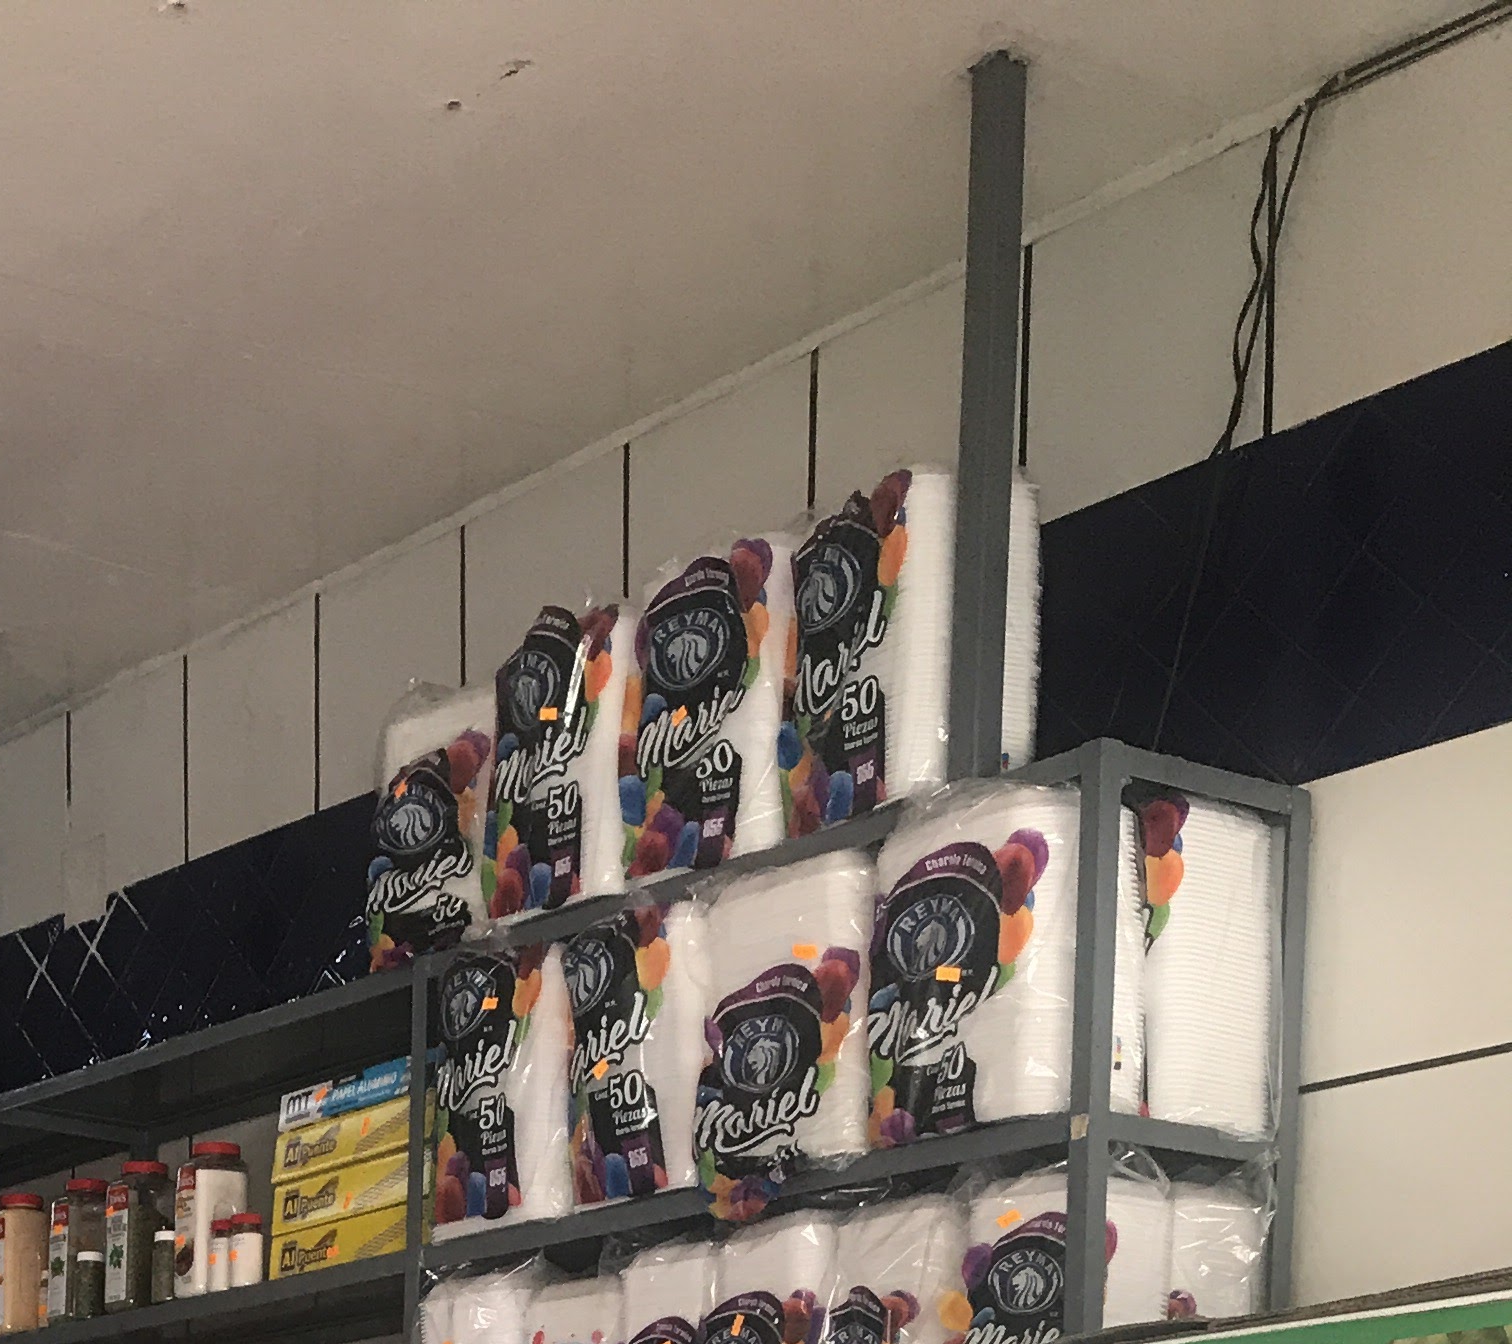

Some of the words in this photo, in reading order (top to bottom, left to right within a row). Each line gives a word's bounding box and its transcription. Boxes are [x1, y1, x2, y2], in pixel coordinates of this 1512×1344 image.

[655, 608, 723, 644] REYMA
[842, 677, 878, 721] 50
[696, 741, 733, 779] 50
[547, 786, 579, 820] 50
[899, 898, 964, 934] REYMA
[937, 1041, 965, 1085] 50
[609, 1072, 642, 1108] 50
[479, 1095, 506, 1130] 50
[695, 1065, 818, 1154] Mariel
[1001, 1250, 1060, 1277] REYMA
